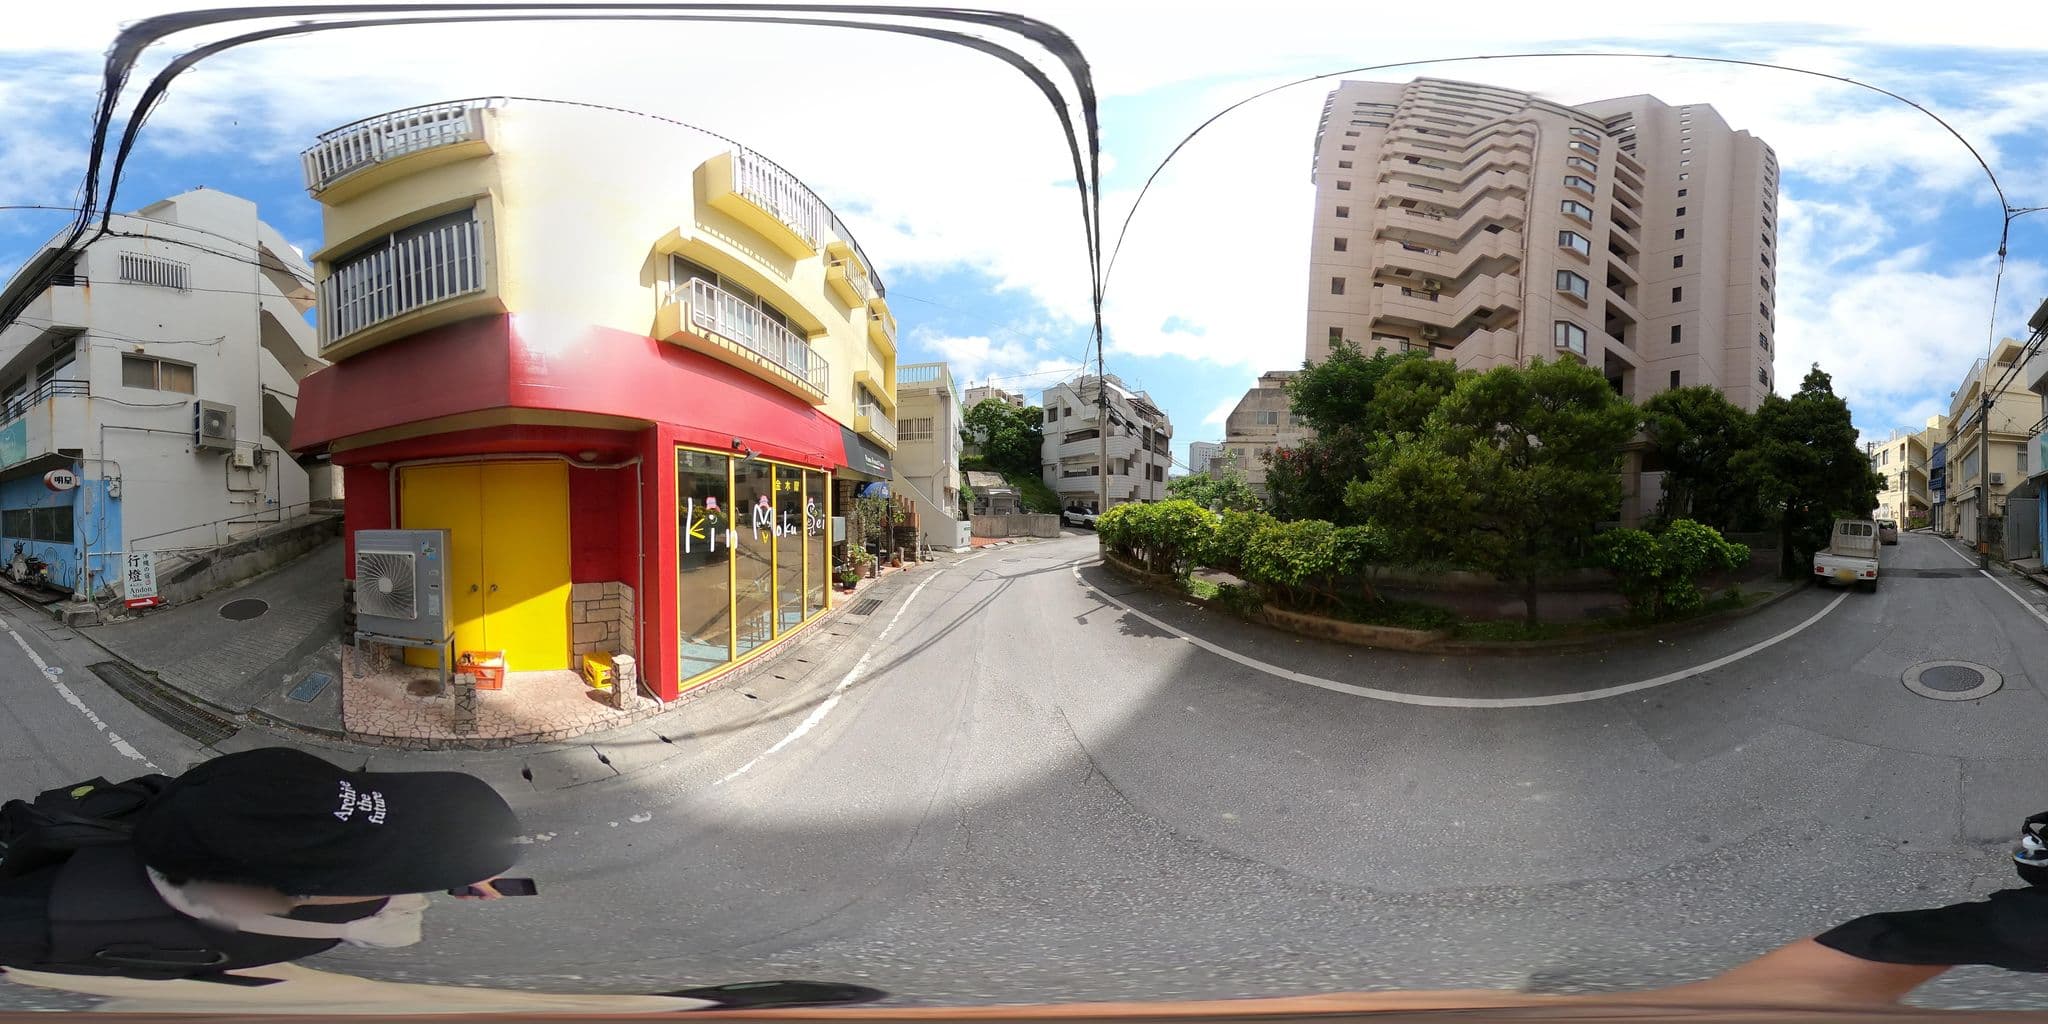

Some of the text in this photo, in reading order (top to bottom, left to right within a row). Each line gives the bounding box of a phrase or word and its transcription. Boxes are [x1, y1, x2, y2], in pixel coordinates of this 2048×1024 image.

[754, 503, 797, 541] Moku
[334, 780, 356, 822] Archie
[356, 793, 373, 811] the
[368, 791, 386, 824] future
